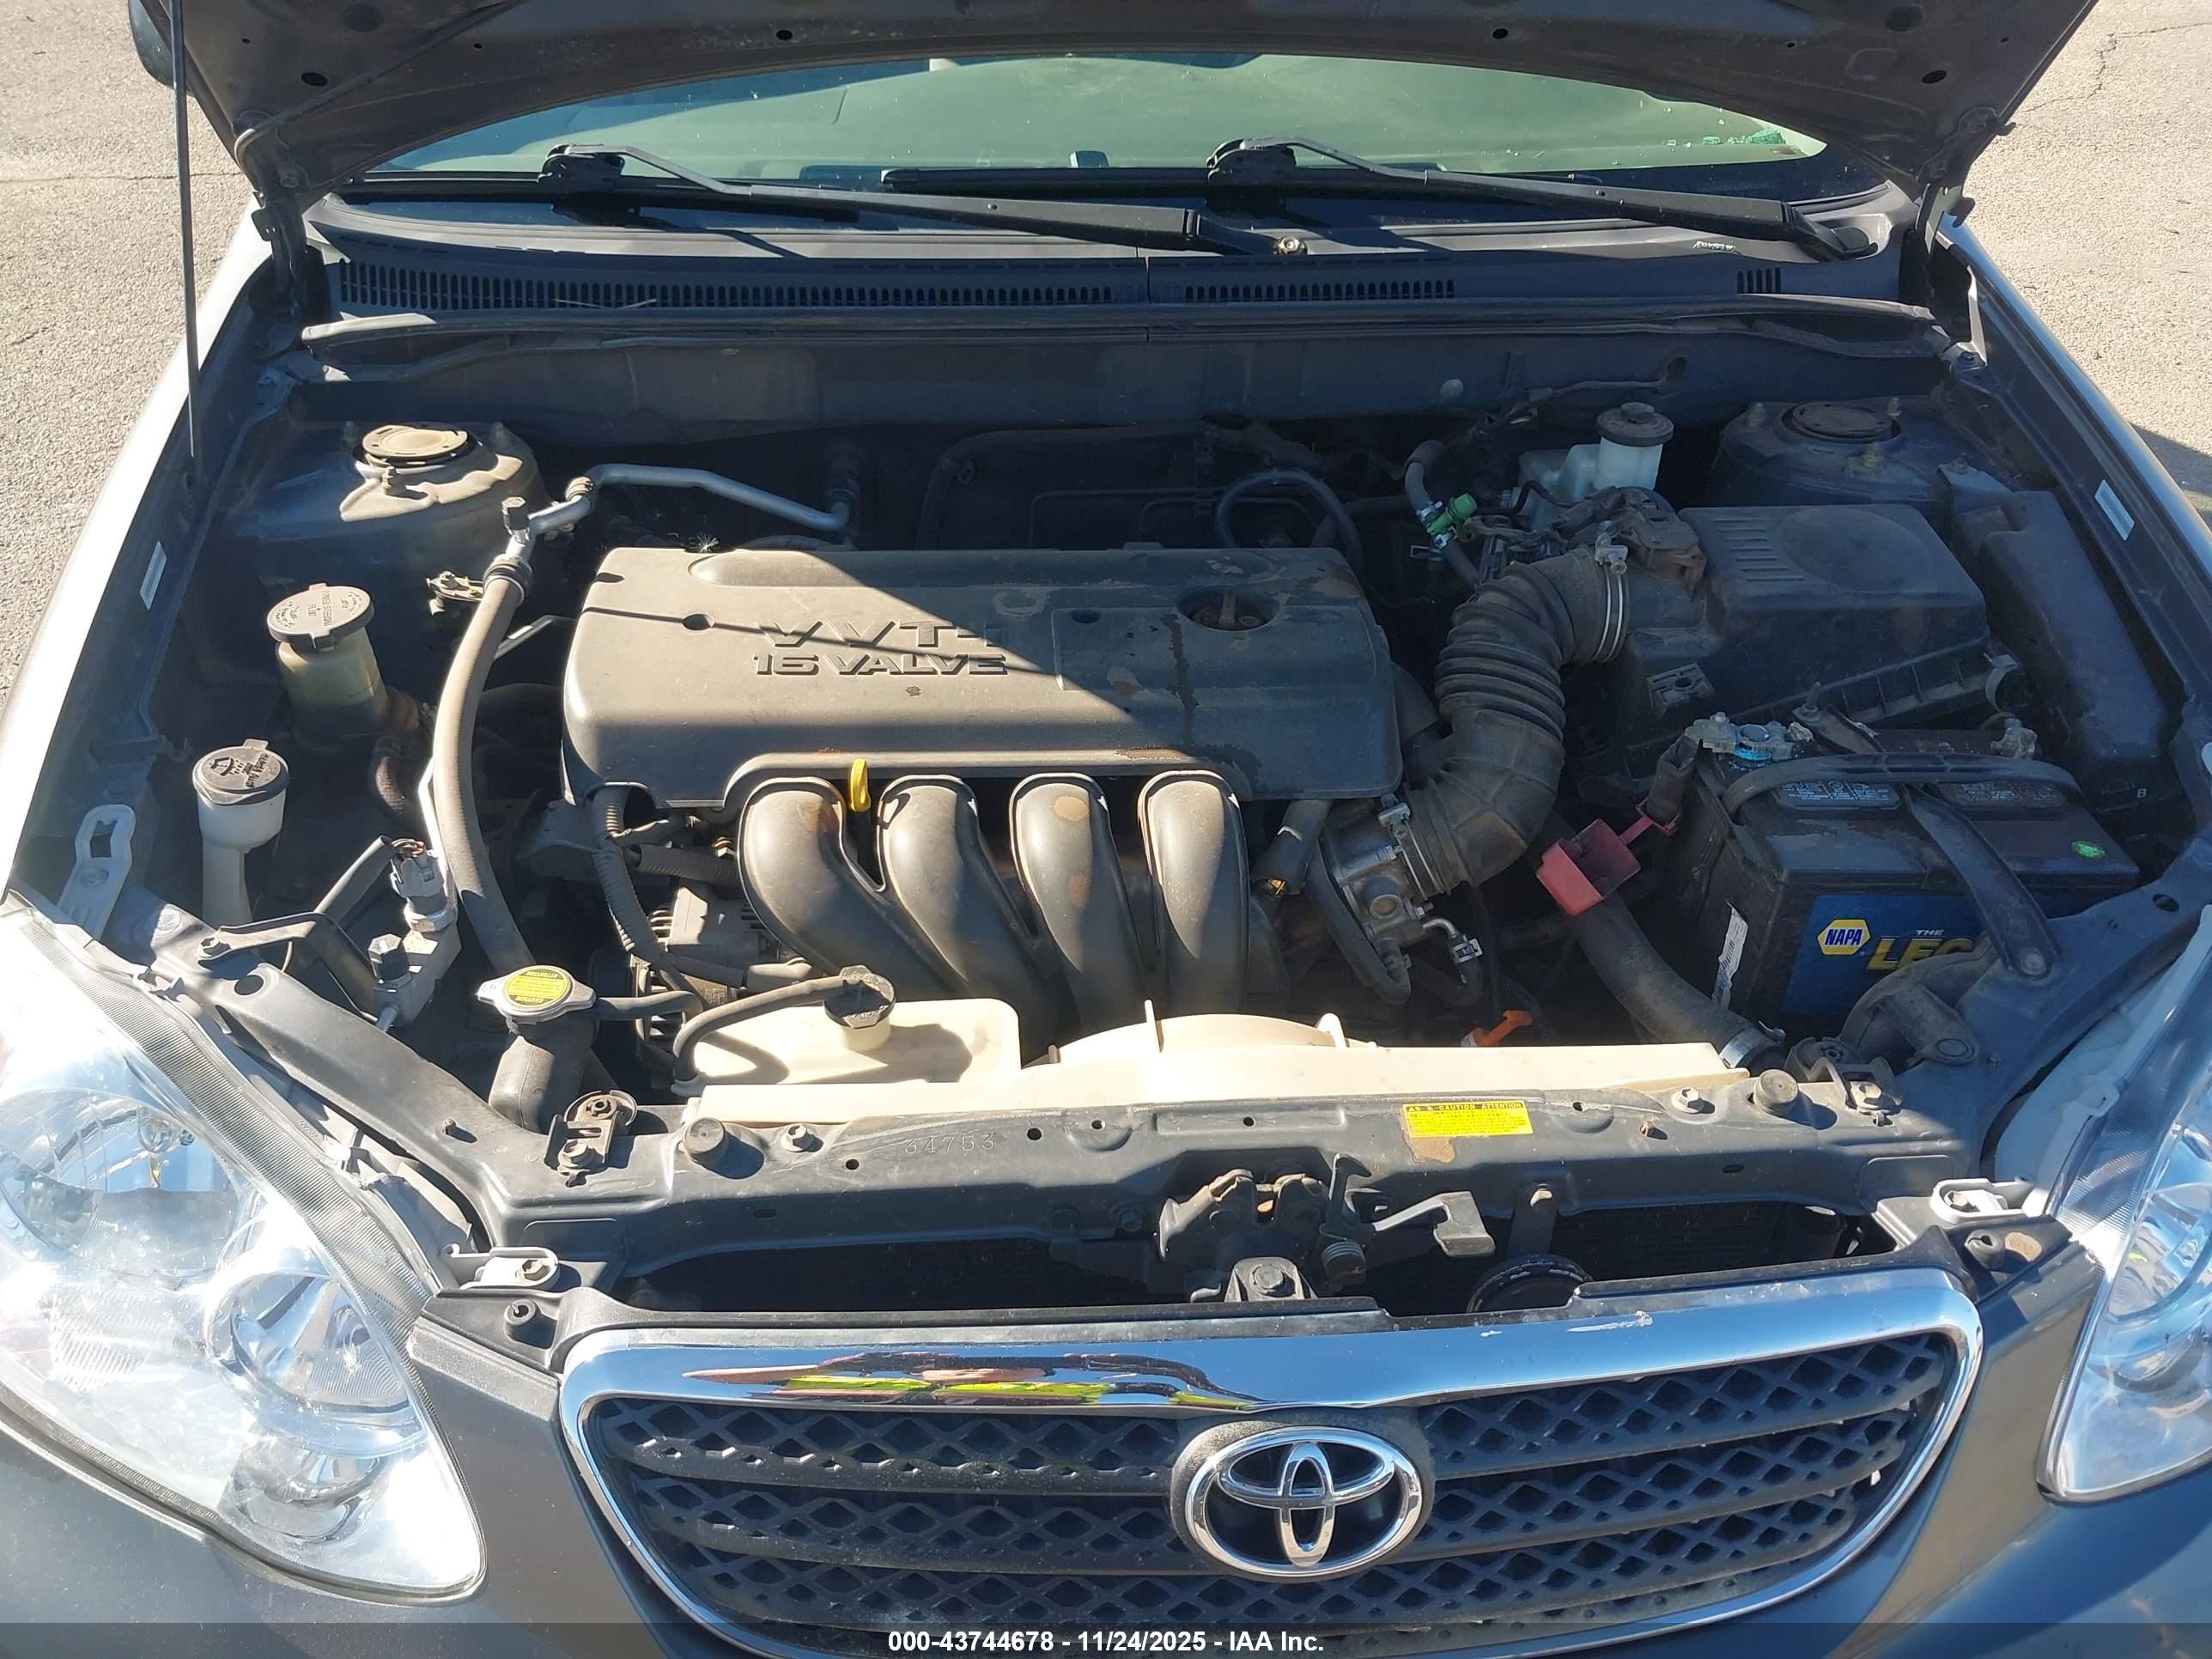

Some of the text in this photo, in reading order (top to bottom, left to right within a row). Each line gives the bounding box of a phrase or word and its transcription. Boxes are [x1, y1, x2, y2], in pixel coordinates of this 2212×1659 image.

[753, 651, 1008, 676] 16 VALVE
[1824, 927, 1863, 946] NAPA
[1916, 928, 1945, 937] THE
[1481, 1102, 1522, 1110] ATTENTION
